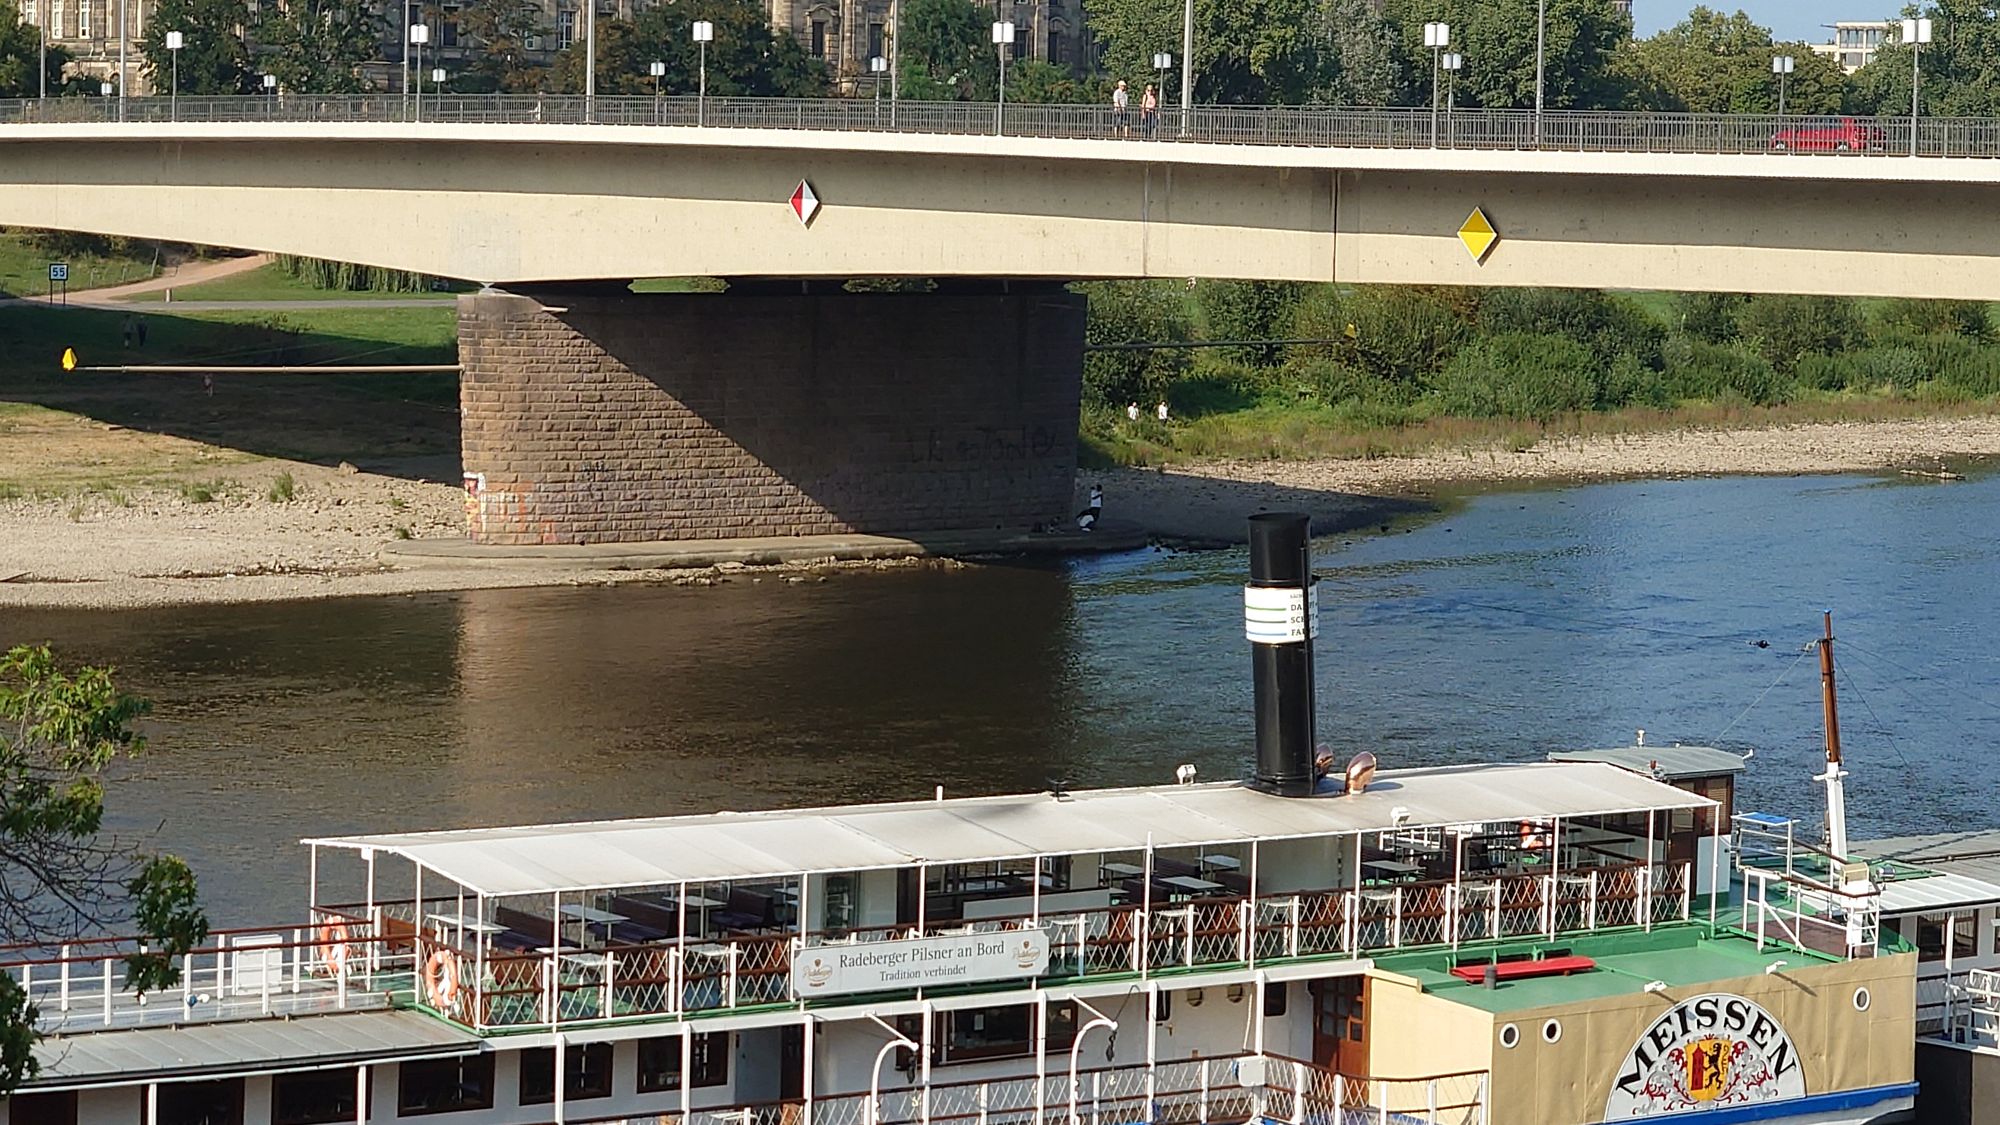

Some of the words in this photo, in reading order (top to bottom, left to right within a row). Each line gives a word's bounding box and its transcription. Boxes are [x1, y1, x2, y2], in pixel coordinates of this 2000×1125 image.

[52, 267, 65, 277] 55
[840, 951, 908, 968] Radeberger
[911, 947, 954, 961] Pilsner
[957, 946, 972, 958] an
[977, 940, 1004, 956] Bord
[880, 969, 920, 982] Tradition
[924, 964, 966, 977] verbindet
[1616, 998, 1797, 1098] MEISSEN
